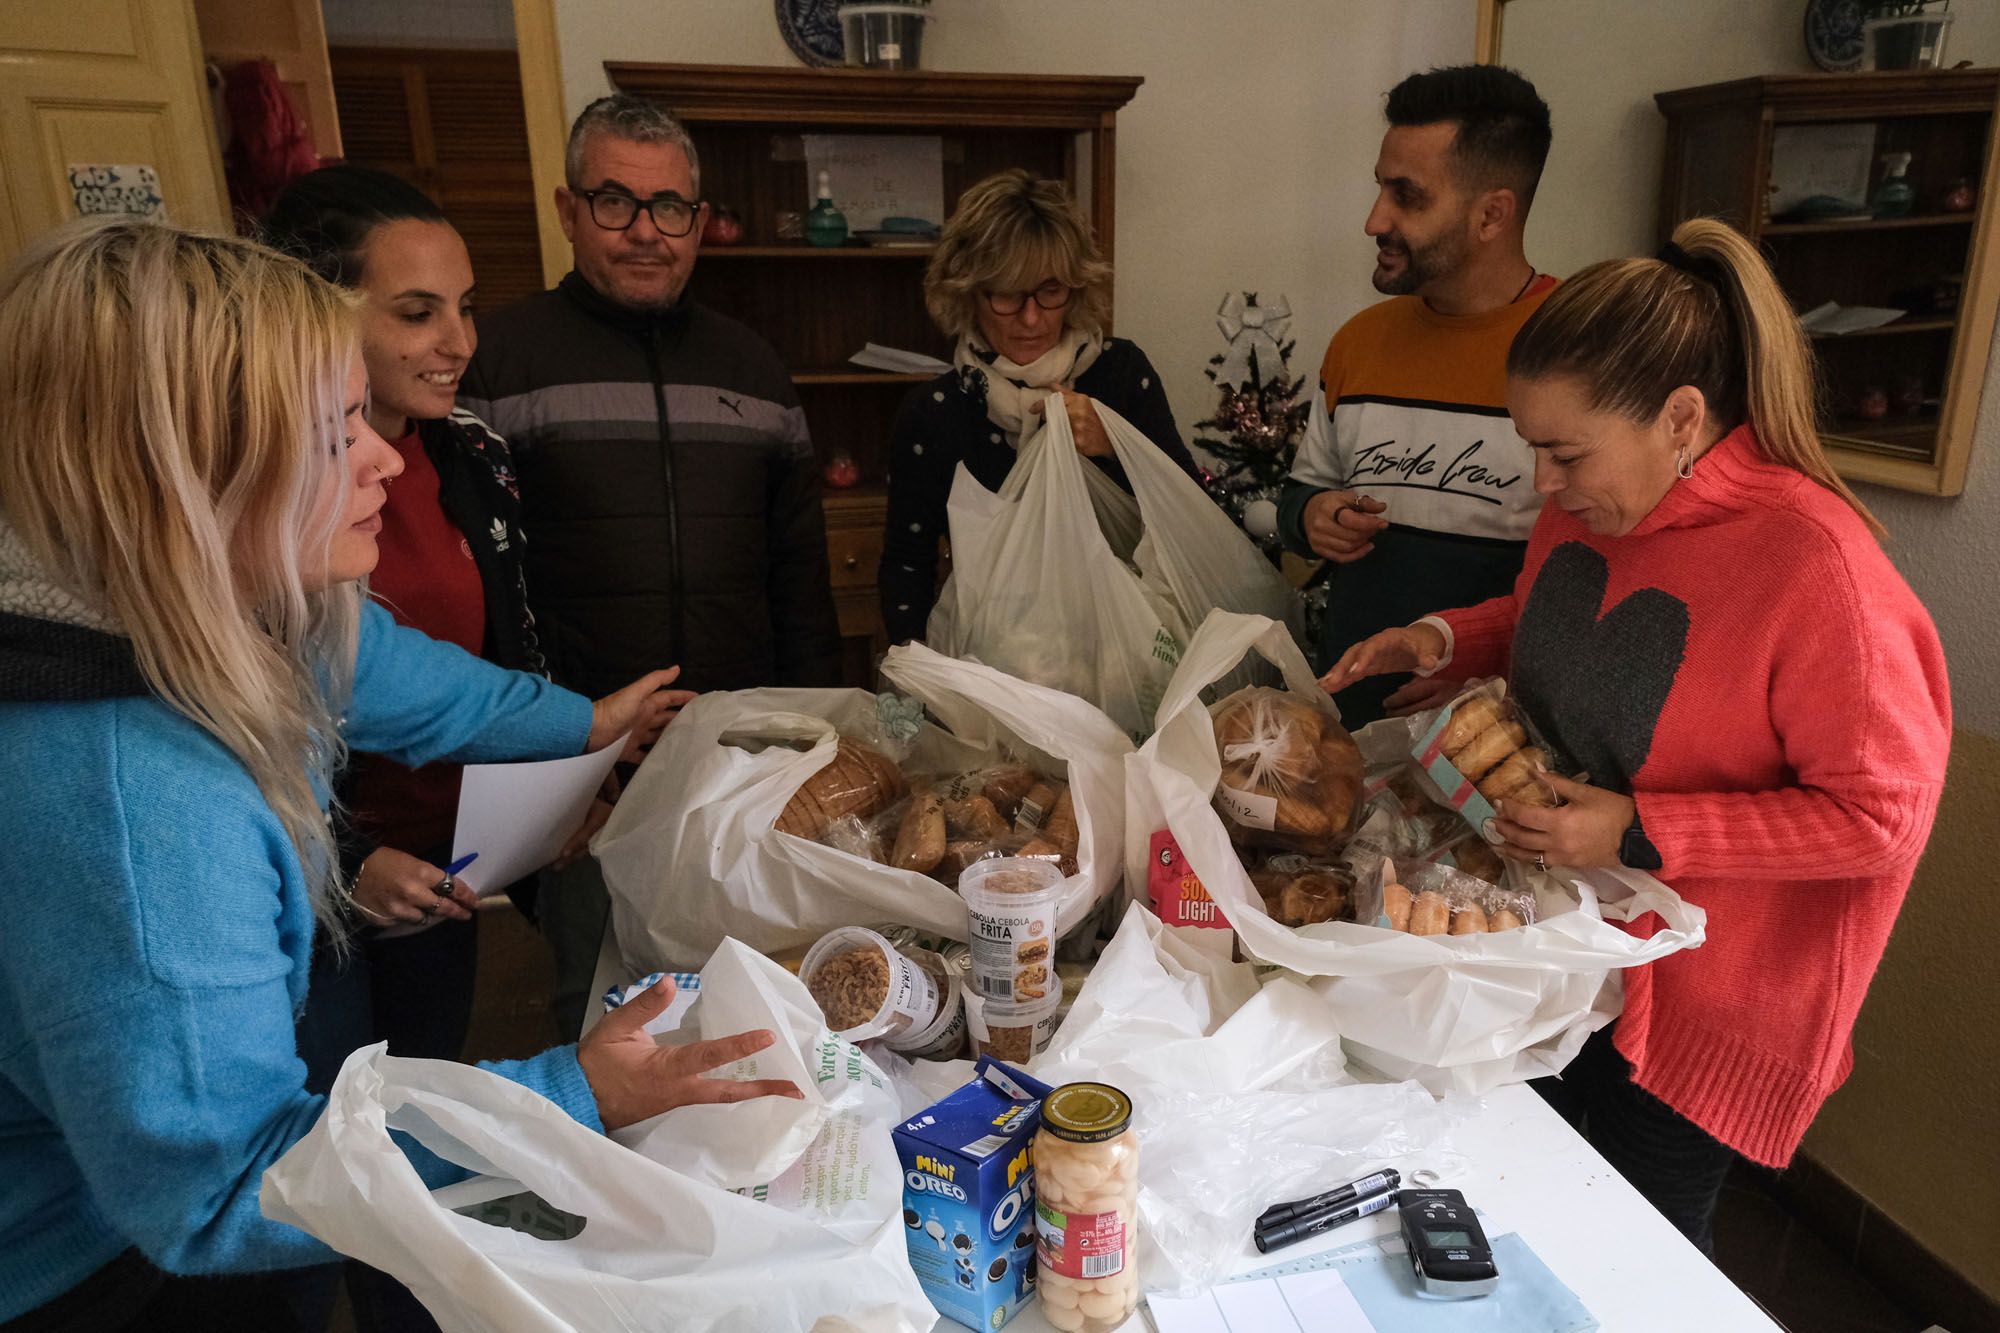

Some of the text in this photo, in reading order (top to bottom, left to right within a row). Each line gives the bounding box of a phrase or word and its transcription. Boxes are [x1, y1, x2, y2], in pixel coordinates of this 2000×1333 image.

[1347, 440, 1521, 488] Inside Crew
[969, 909, 1030, 927] CEBOLLA CEBOLA
[1179, 900, 1217, 921] LIGHT
[980, 923, 1012, 940] FRITA
[906, 1171, 966, 1201] OREO
